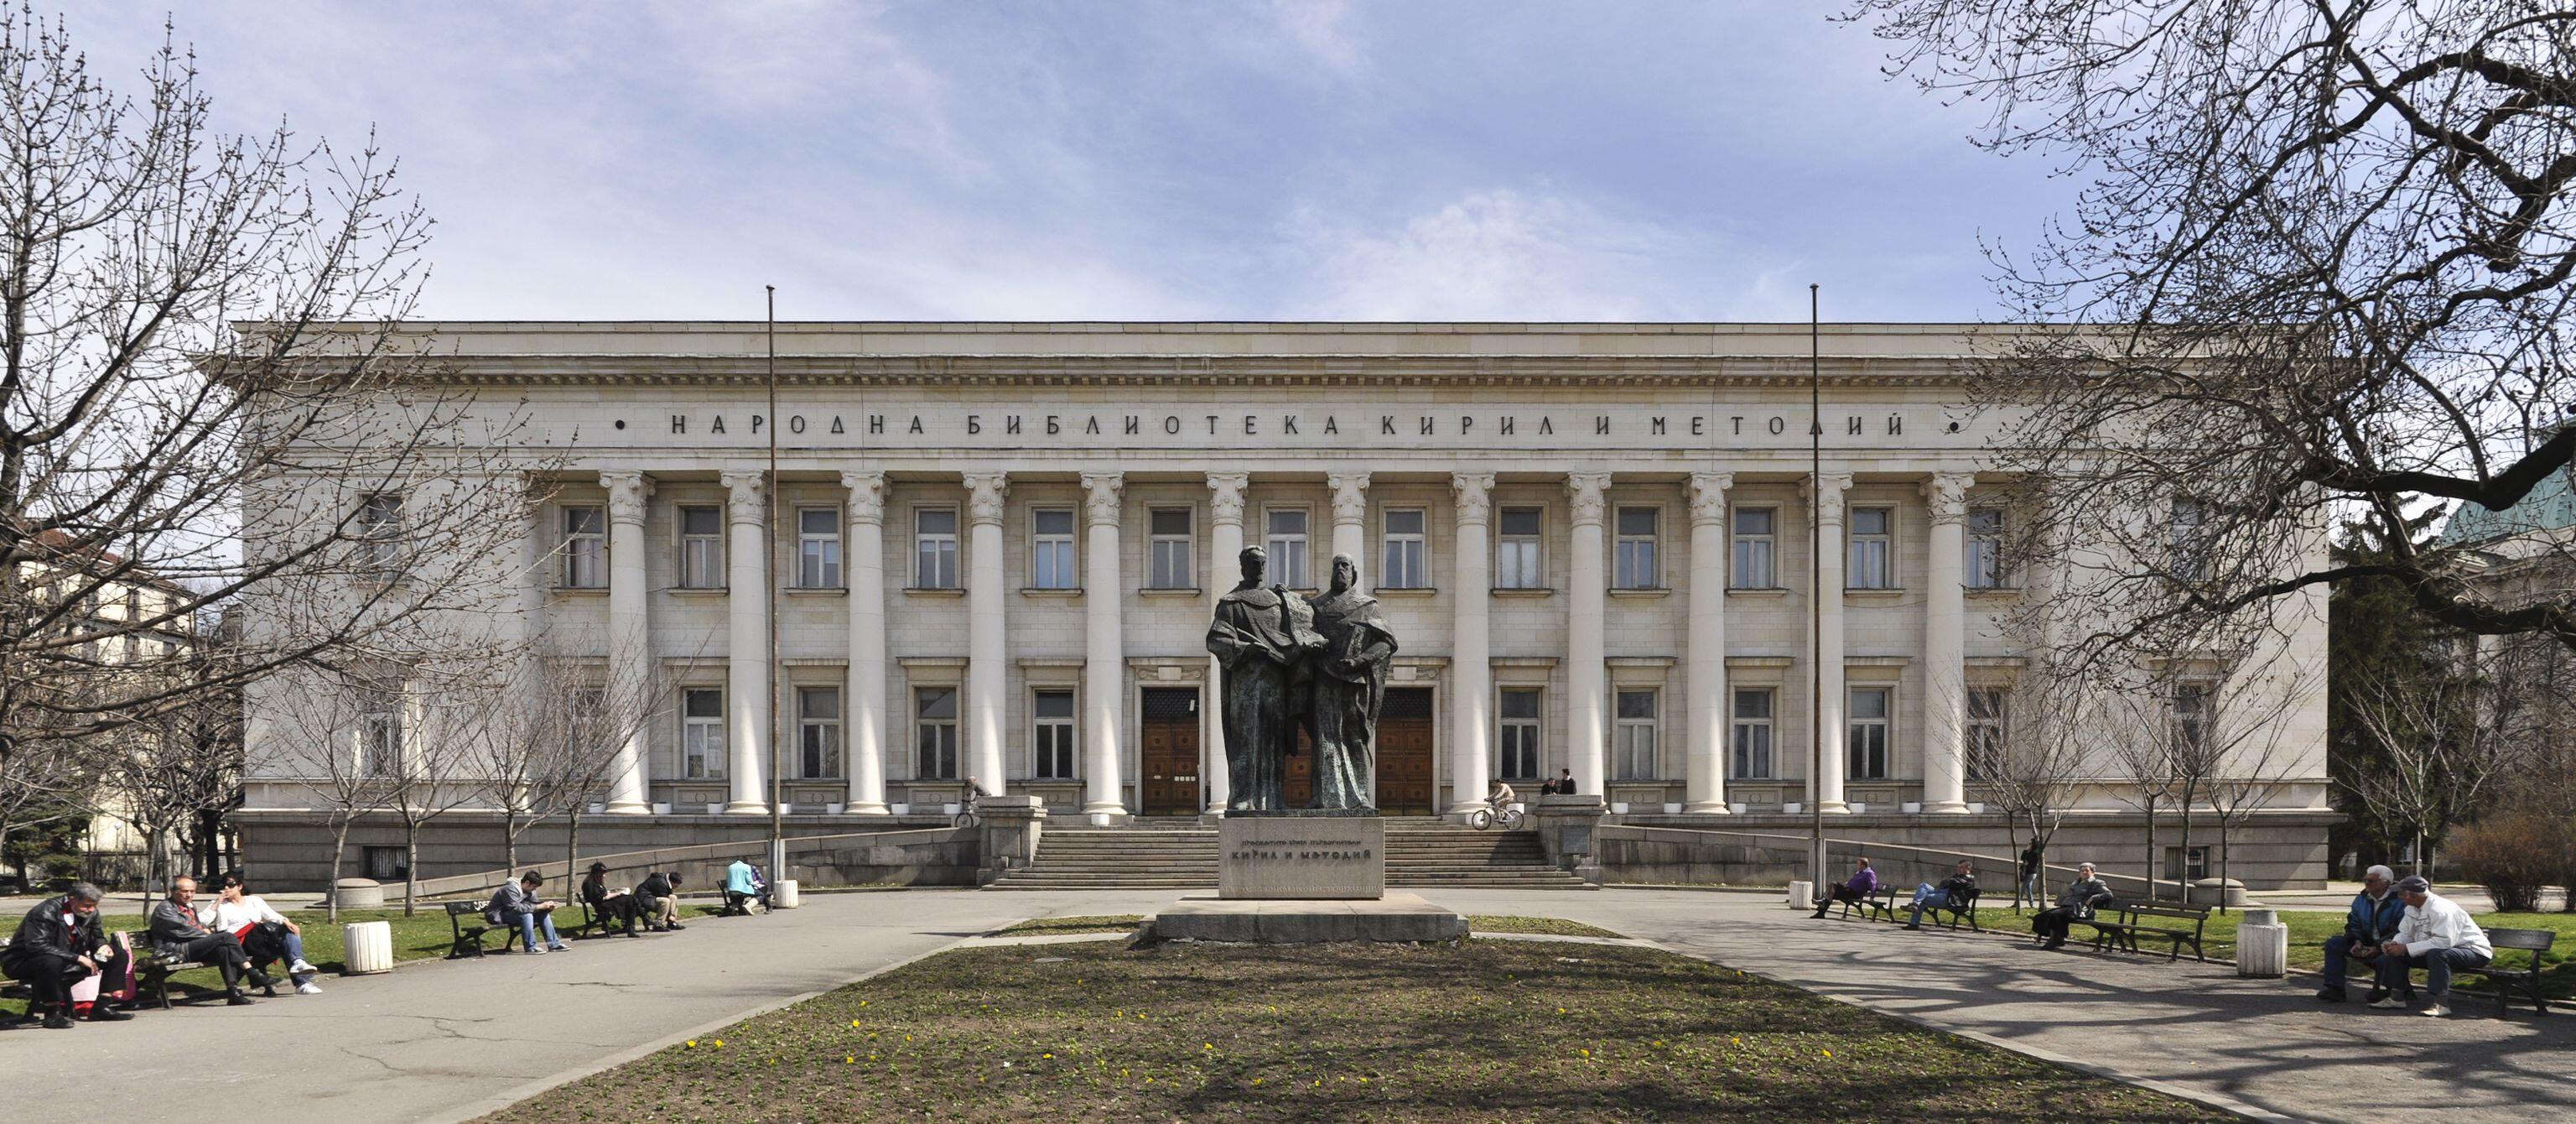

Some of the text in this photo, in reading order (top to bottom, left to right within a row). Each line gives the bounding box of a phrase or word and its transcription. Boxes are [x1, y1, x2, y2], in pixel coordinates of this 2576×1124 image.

[671, 413, 1903, 435] НАРОДНА БИБЛИОТЕКА КИРИЛ И МЕТОДИЙ
